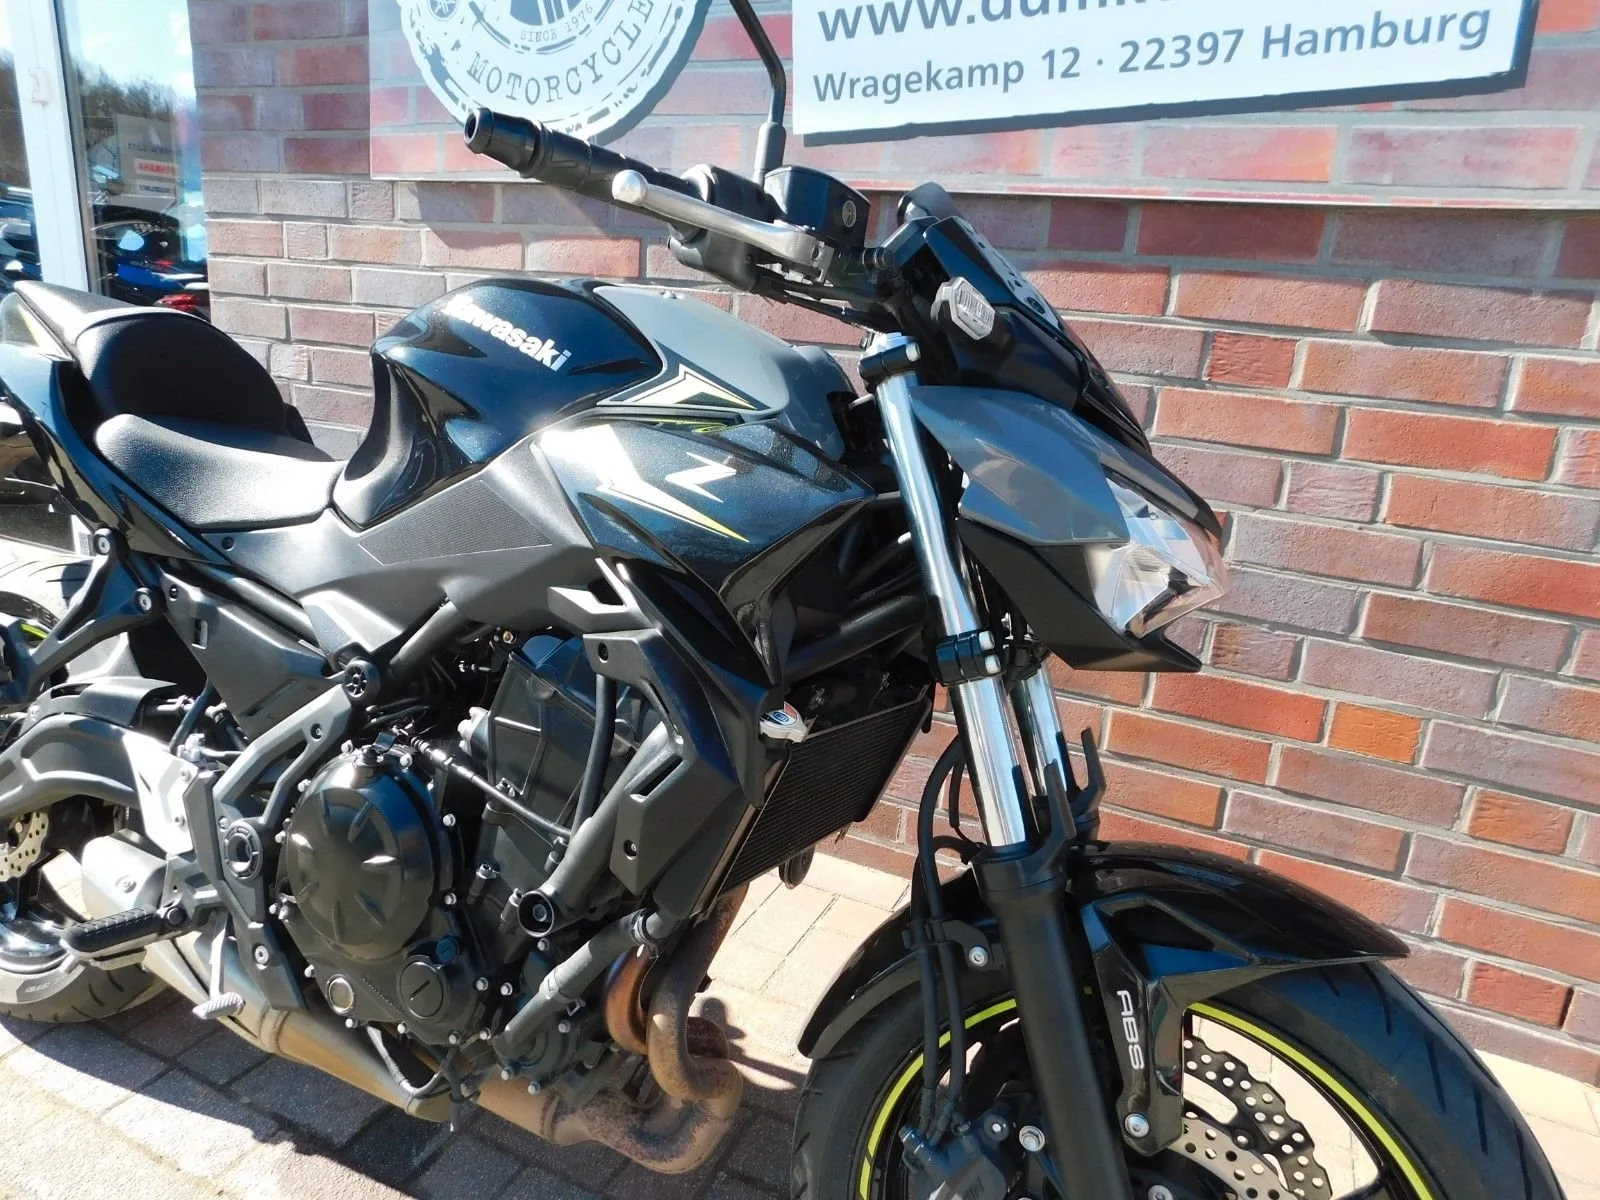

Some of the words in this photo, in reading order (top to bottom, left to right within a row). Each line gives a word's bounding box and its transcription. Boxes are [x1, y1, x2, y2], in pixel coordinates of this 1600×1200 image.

[565, 3, 593, 32] 1976
[812, 60, 1025, 105] Wragekamp
[1041, 46, 1081, 80] 12
[1118, 29, 1245, 74] 22397
[1261, 8, 1491, 60] Hamburg
[444, 293, 572, 371] wasaki
[1116, 990, 1145, 1070] ABS
